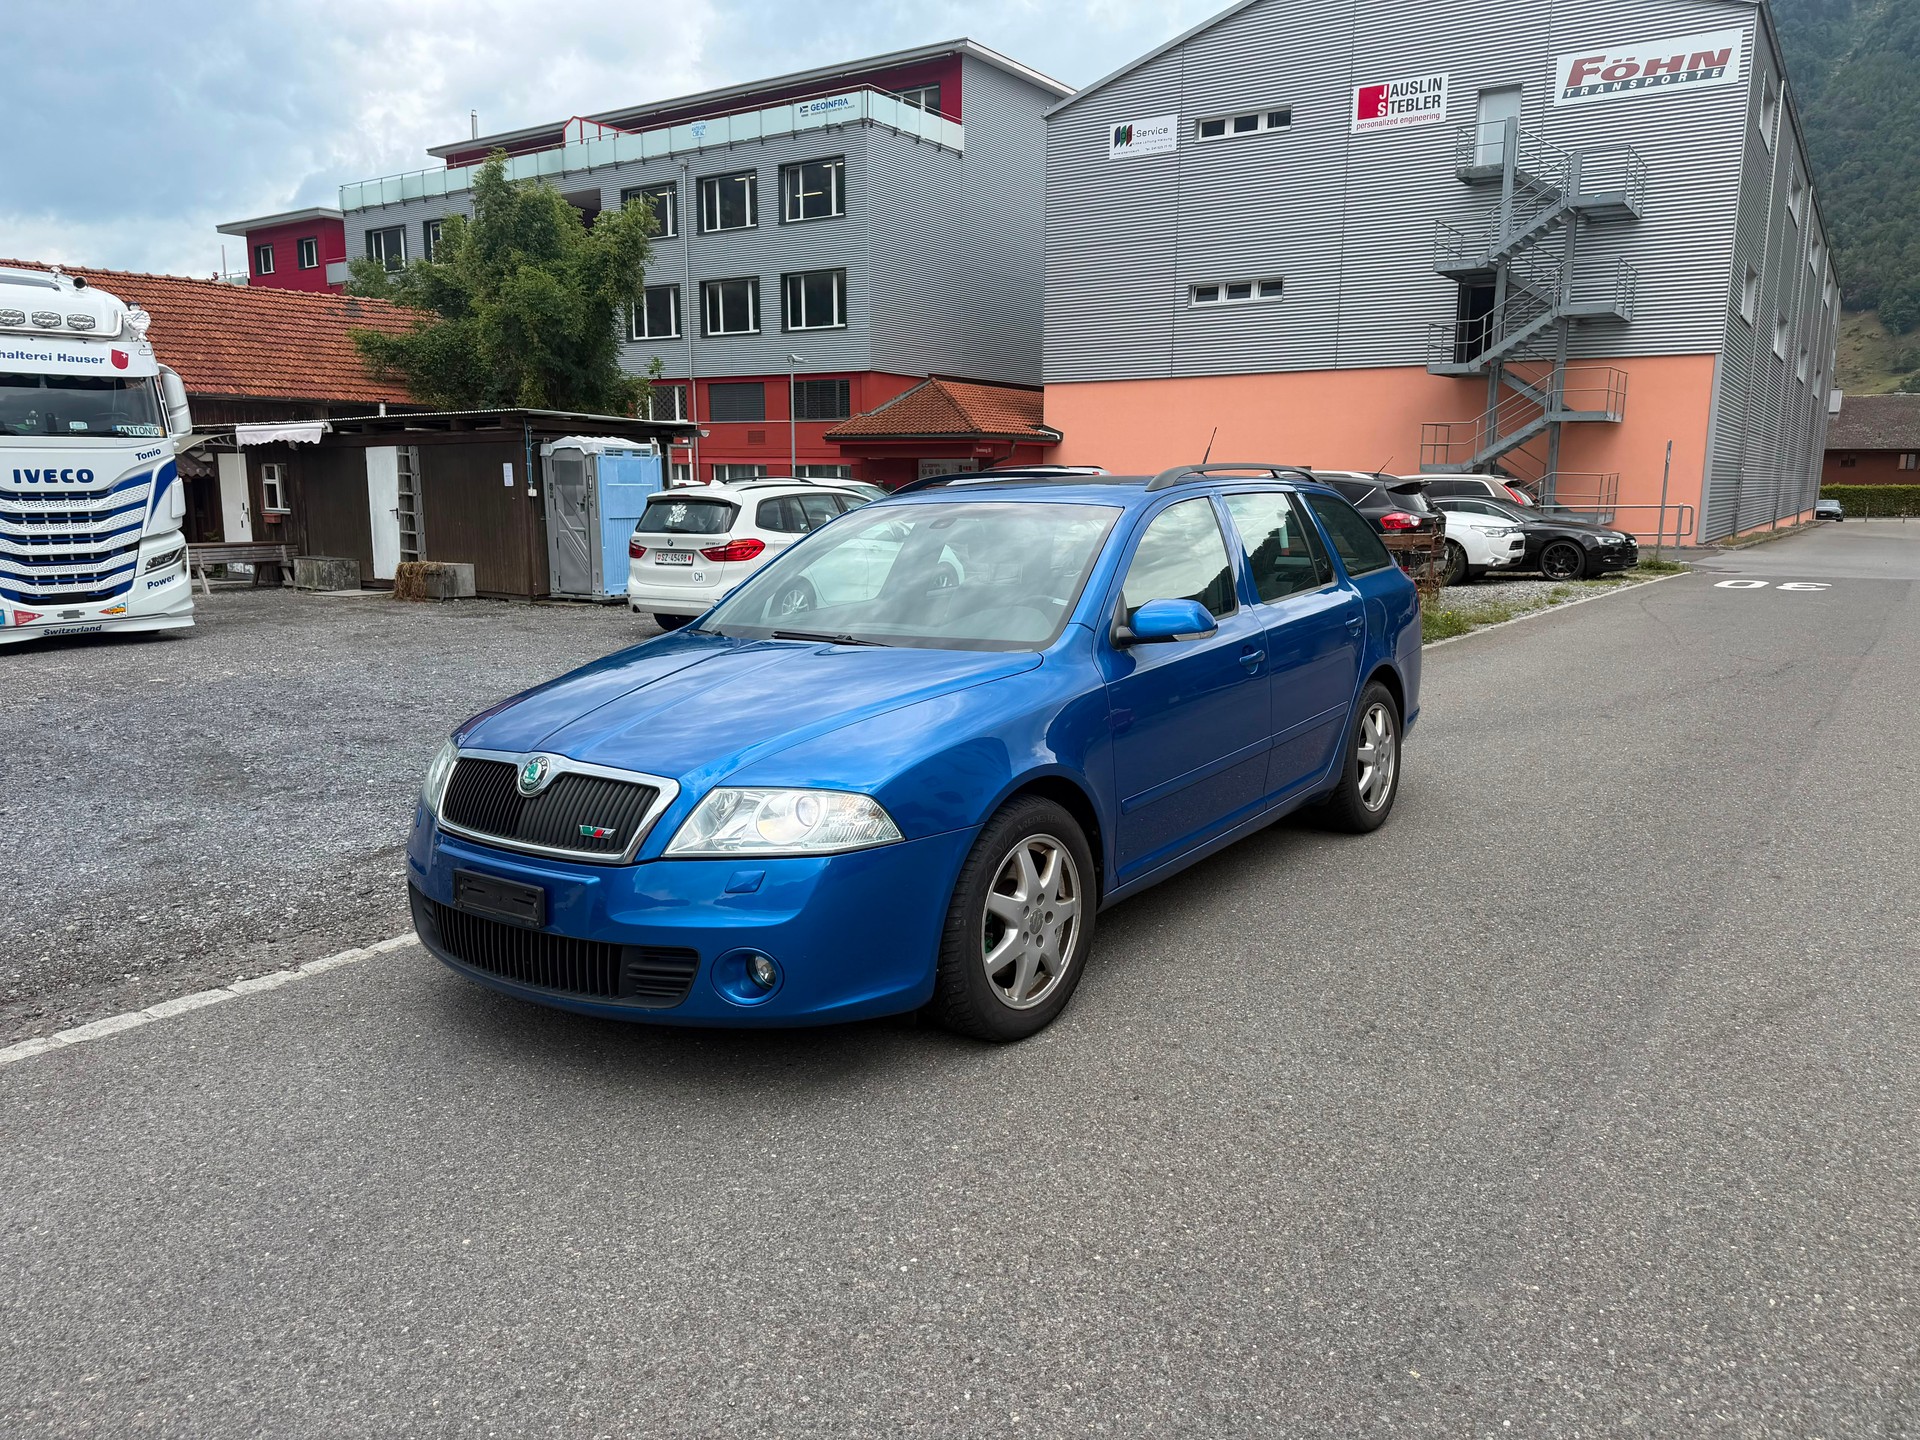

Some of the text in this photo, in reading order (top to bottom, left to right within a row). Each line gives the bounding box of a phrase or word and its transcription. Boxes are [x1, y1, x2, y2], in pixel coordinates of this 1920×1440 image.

[1379, 77, 1442, 100] JAUSLIN
[1566, 67, 1721, 98] TRANSPORTE
[810, 98, 849, 112] GEOINFRA
[1377, 94, 1441, 117] STEBLER
[1356, 112, 1440, 131] personalized engineering
[57, 352, 105, 364] Hauser
[119, 426, 159, 436] ANTONIO
[135, 447, 162, 461] Tonio
[13, 468, 94, 484] IVECO
[147, 573, 176, 590] Power
[694, 572, 704, 582] CH
[43, 624, 102, 636] Switzerland
